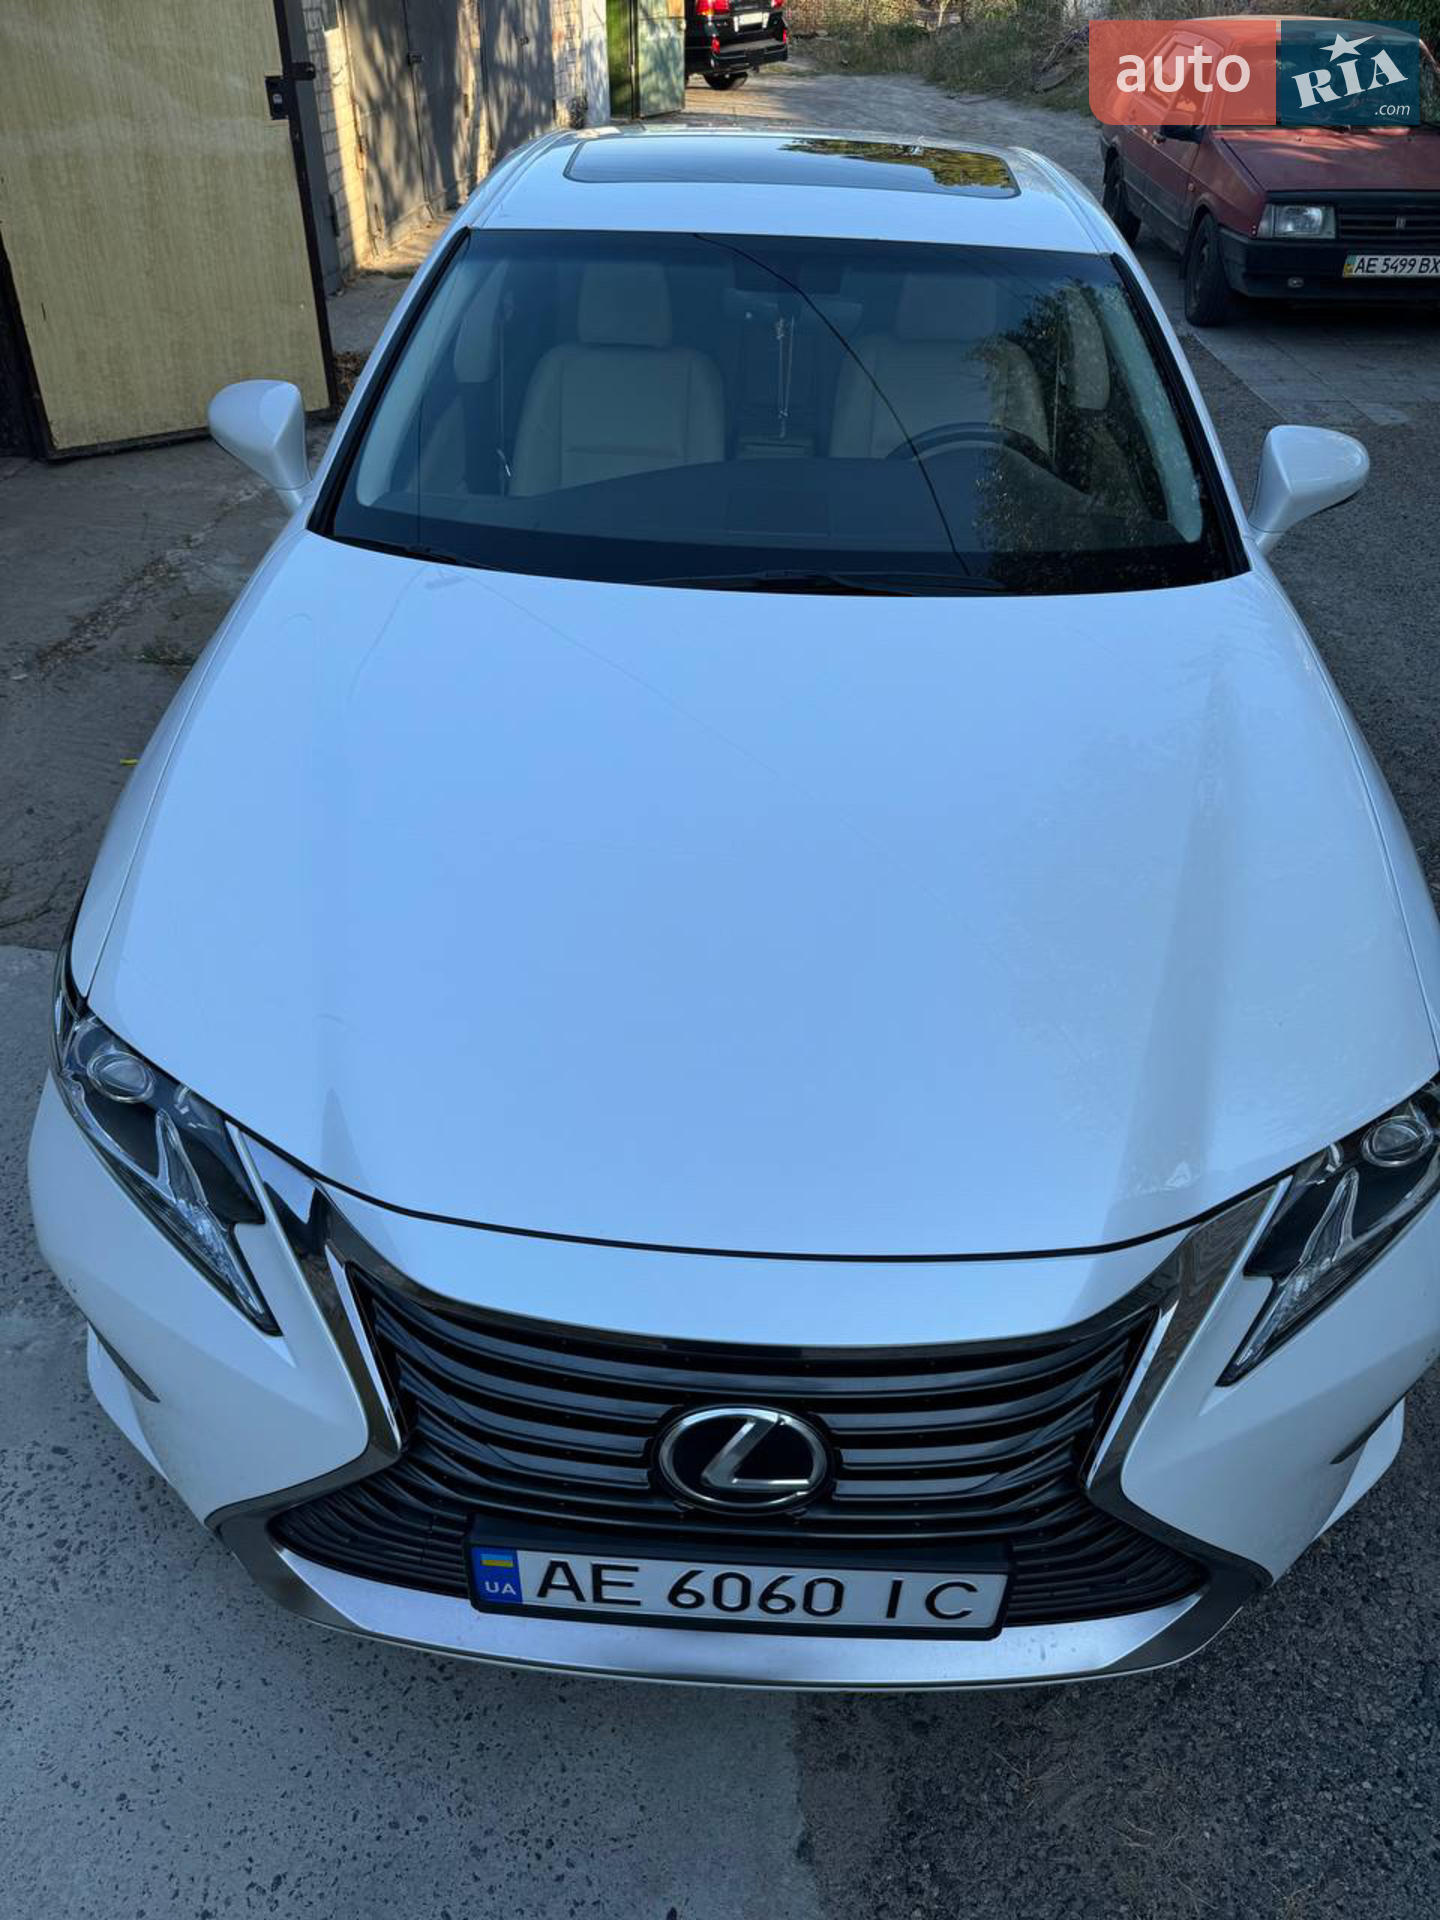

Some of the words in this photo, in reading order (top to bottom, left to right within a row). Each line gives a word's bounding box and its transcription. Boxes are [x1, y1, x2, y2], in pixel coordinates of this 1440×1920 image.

[1354, 257, 1379, 274] AE
[1381, 257, 1417, 274] 5499
[1418, 257, 1440, 274] BX
[485, 1580, 517, 1596] UA
[536, 1559, 642, 1607] AE
[667, 1569, 845, 1618] 6060
